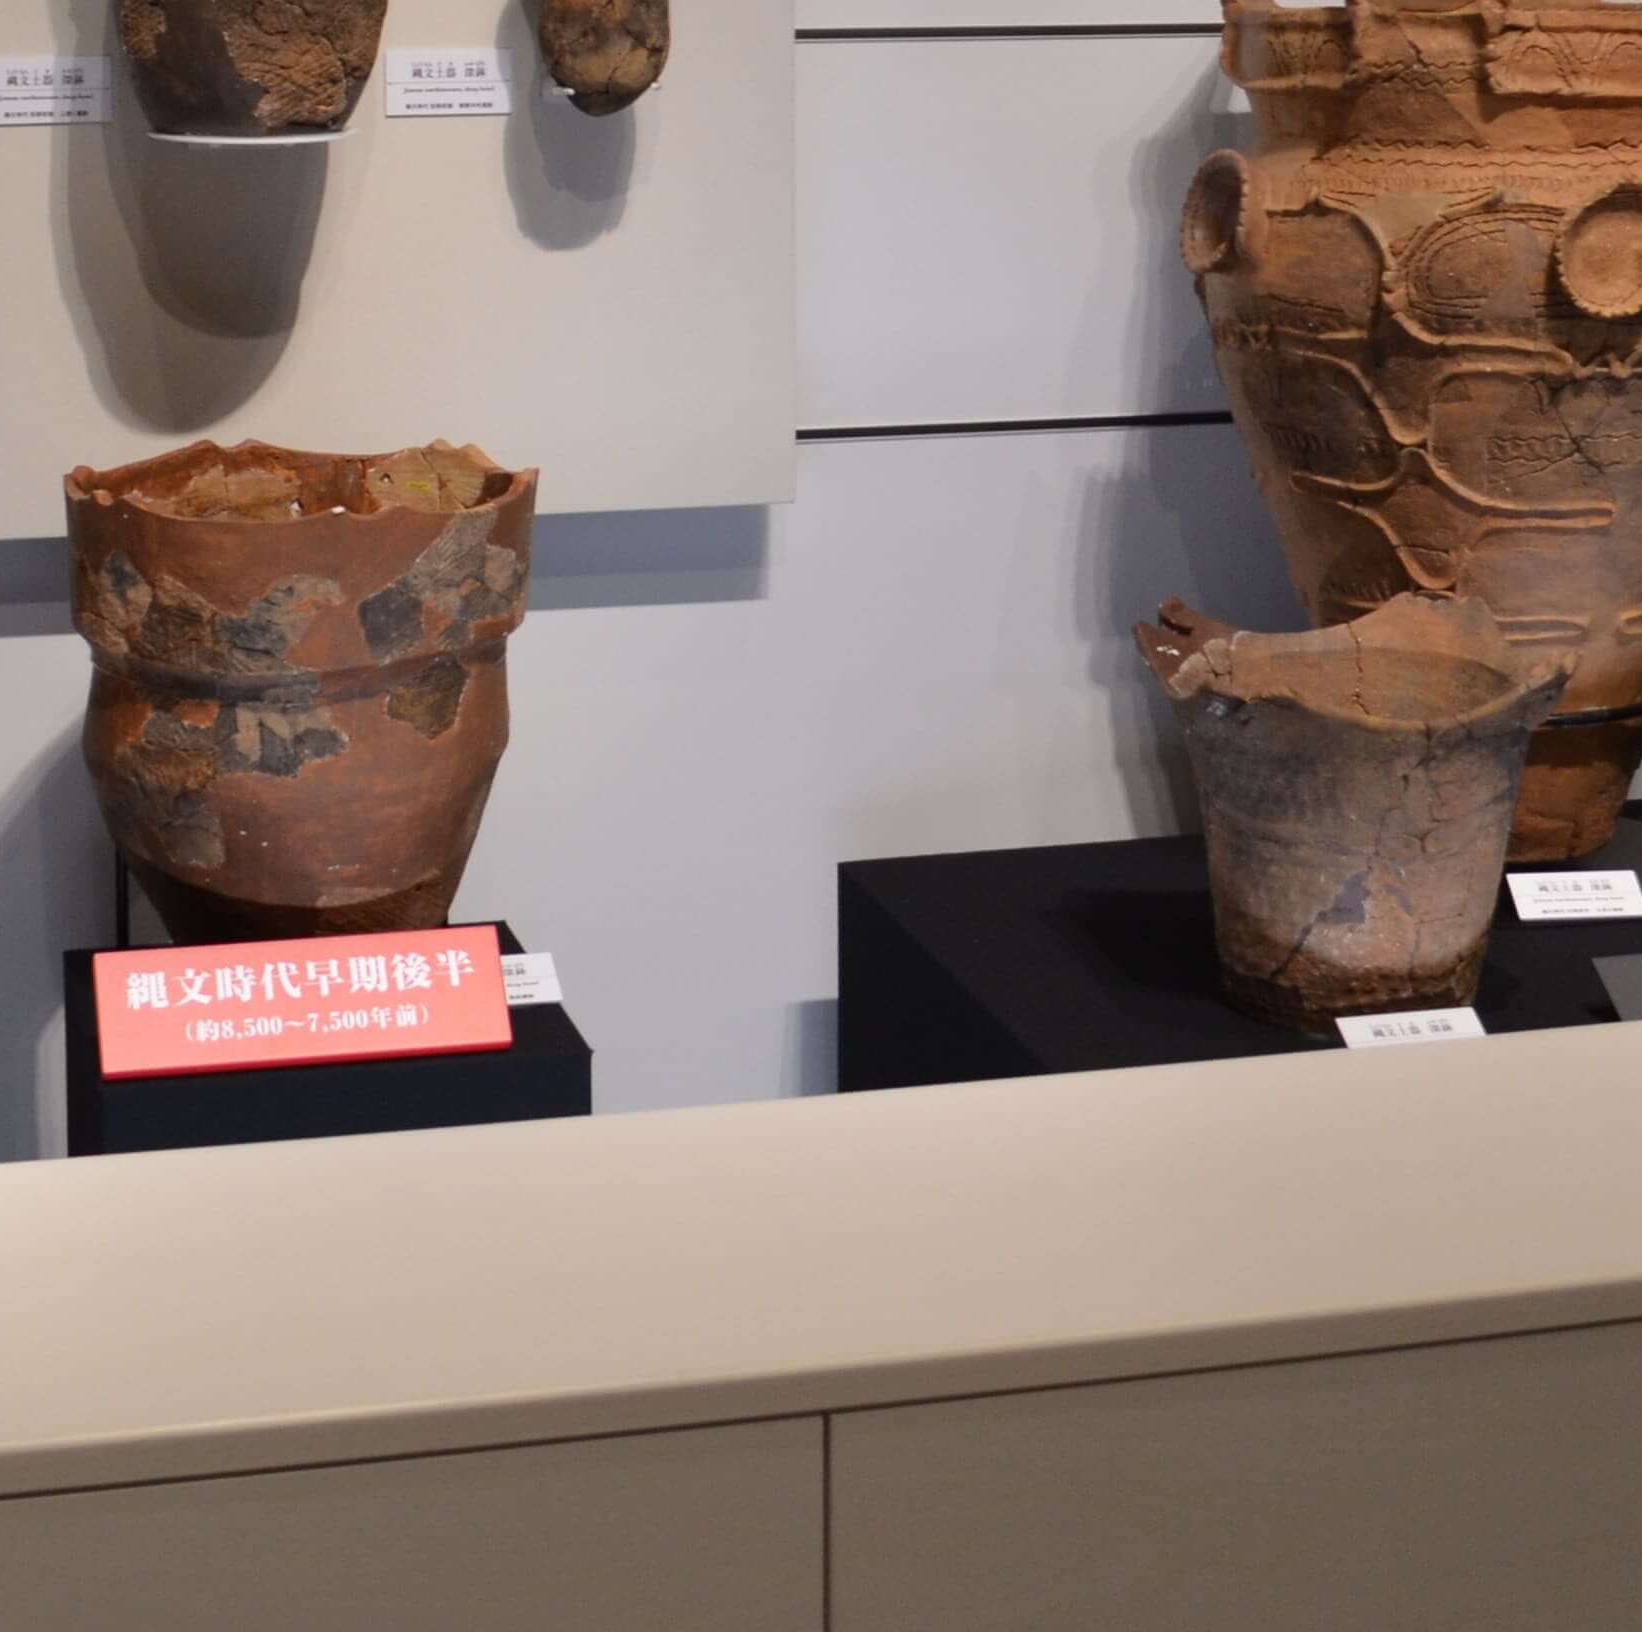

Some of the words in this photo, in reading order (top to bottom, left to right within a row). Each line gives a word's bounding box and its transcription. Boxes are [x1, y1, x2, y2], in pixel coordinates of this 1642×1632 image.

[126, 950, 476, 1011] 縄文時代早期後半
